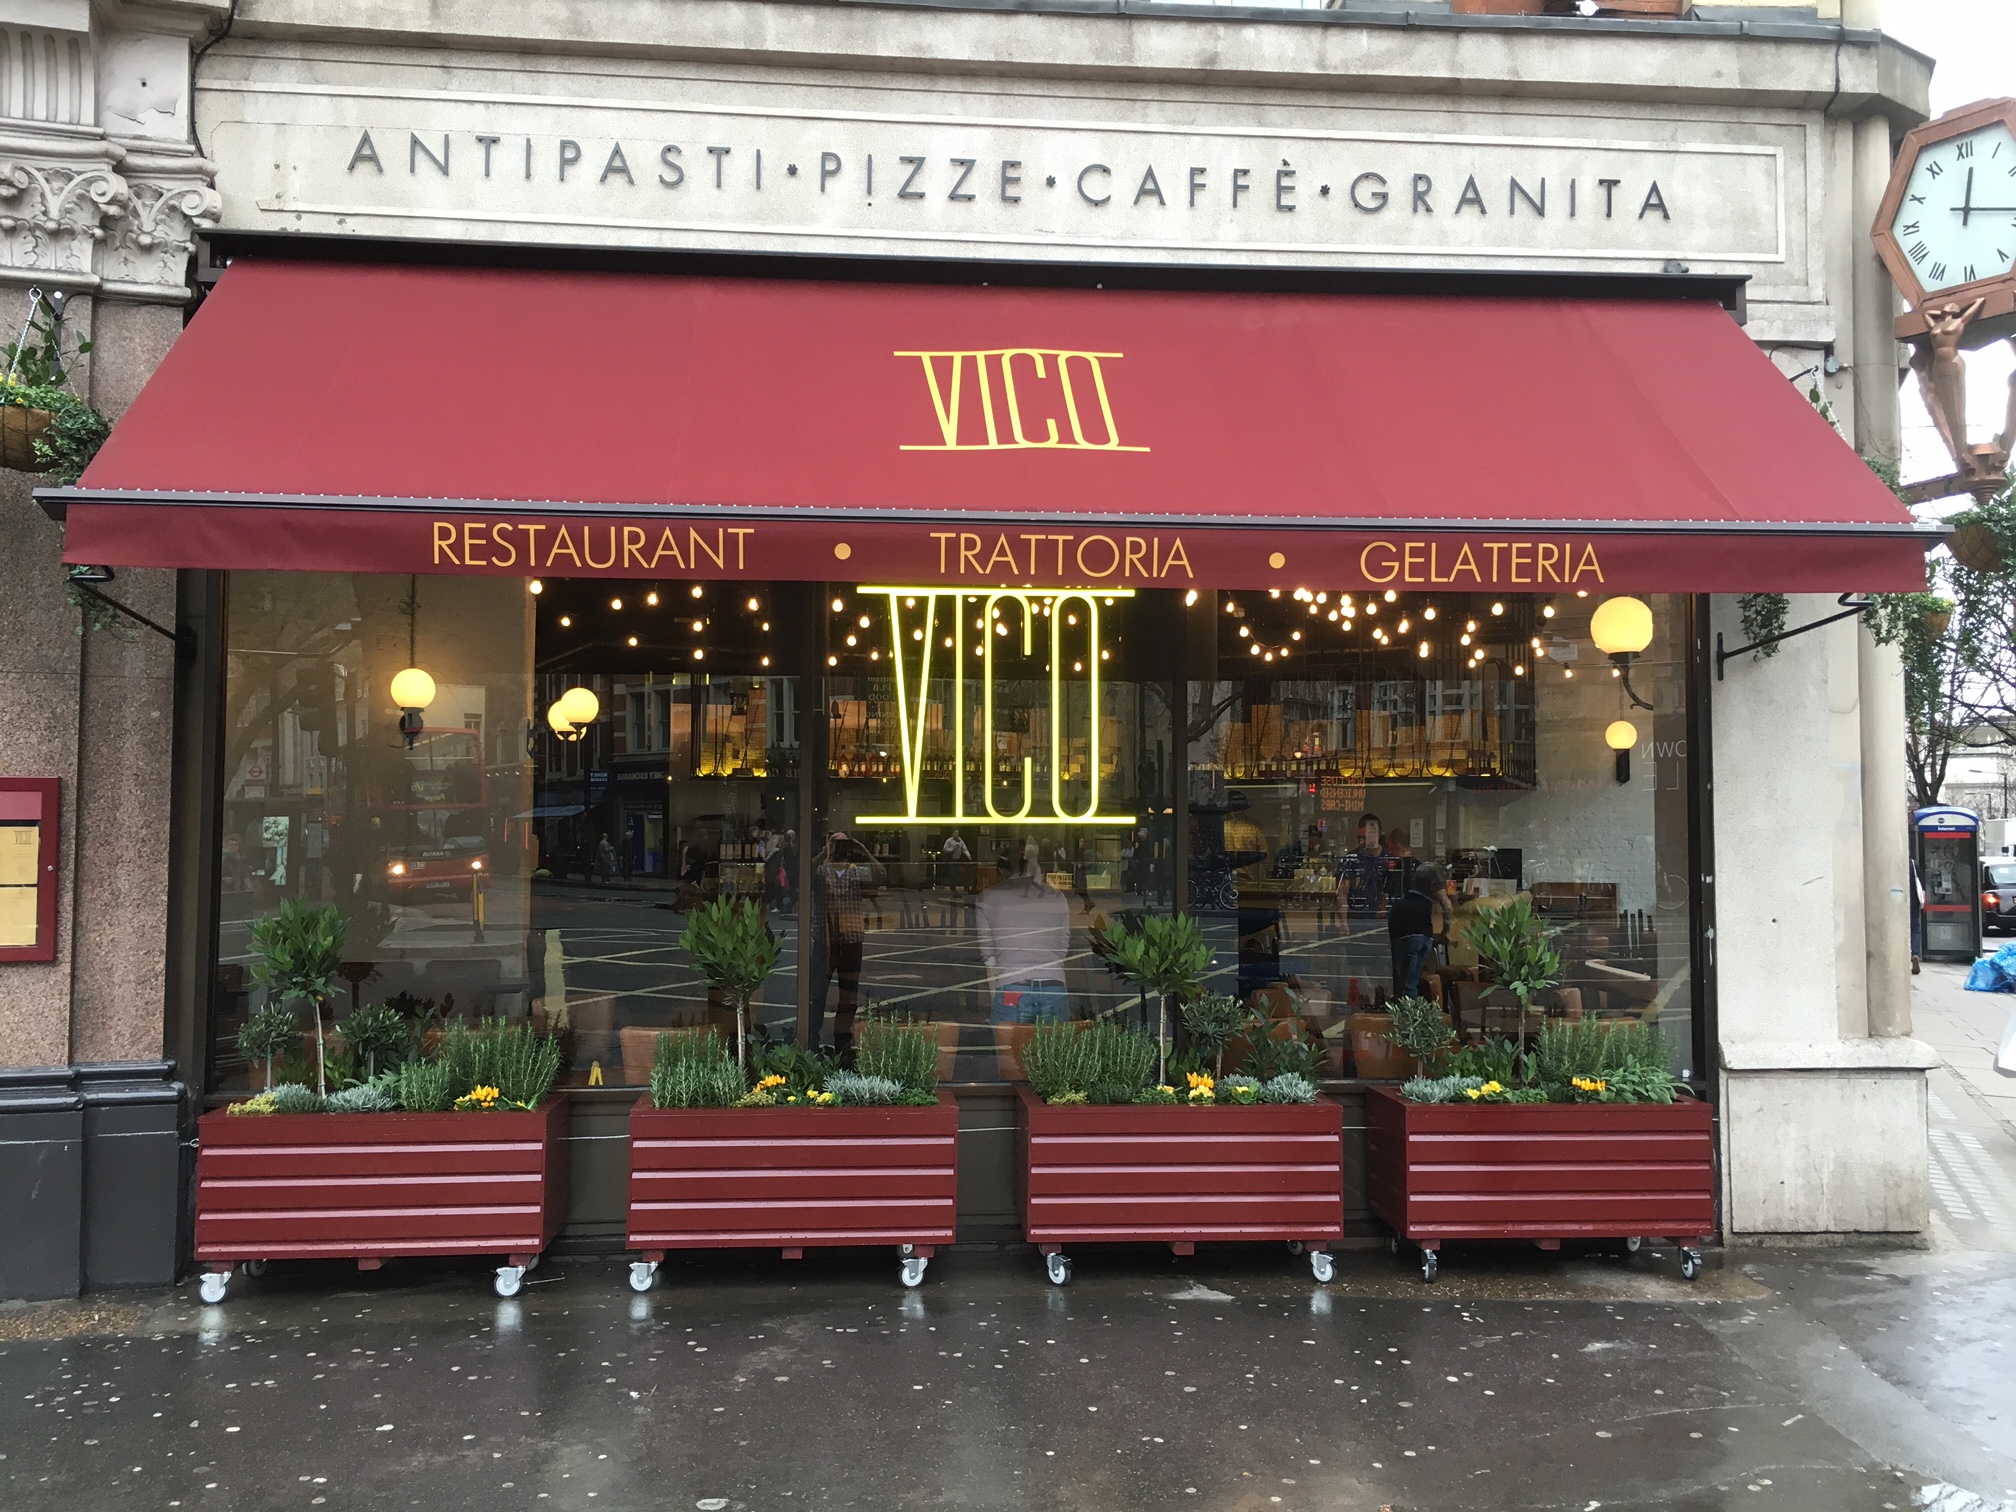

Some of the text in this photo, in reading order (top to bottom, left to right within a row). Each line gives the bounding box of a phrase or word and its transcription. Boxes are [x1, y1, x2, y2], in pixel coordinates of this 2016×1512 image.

[347, 129, 1671, 221] ANTIPASTI PIZZE CAFFÈ GRANITA
[894, 347, 1151, 452] VICO
[432, 521, 1605, 585] RESTAURANT TRATTORIA GELATERIA
[856, 585, 1136, 825] VICO
